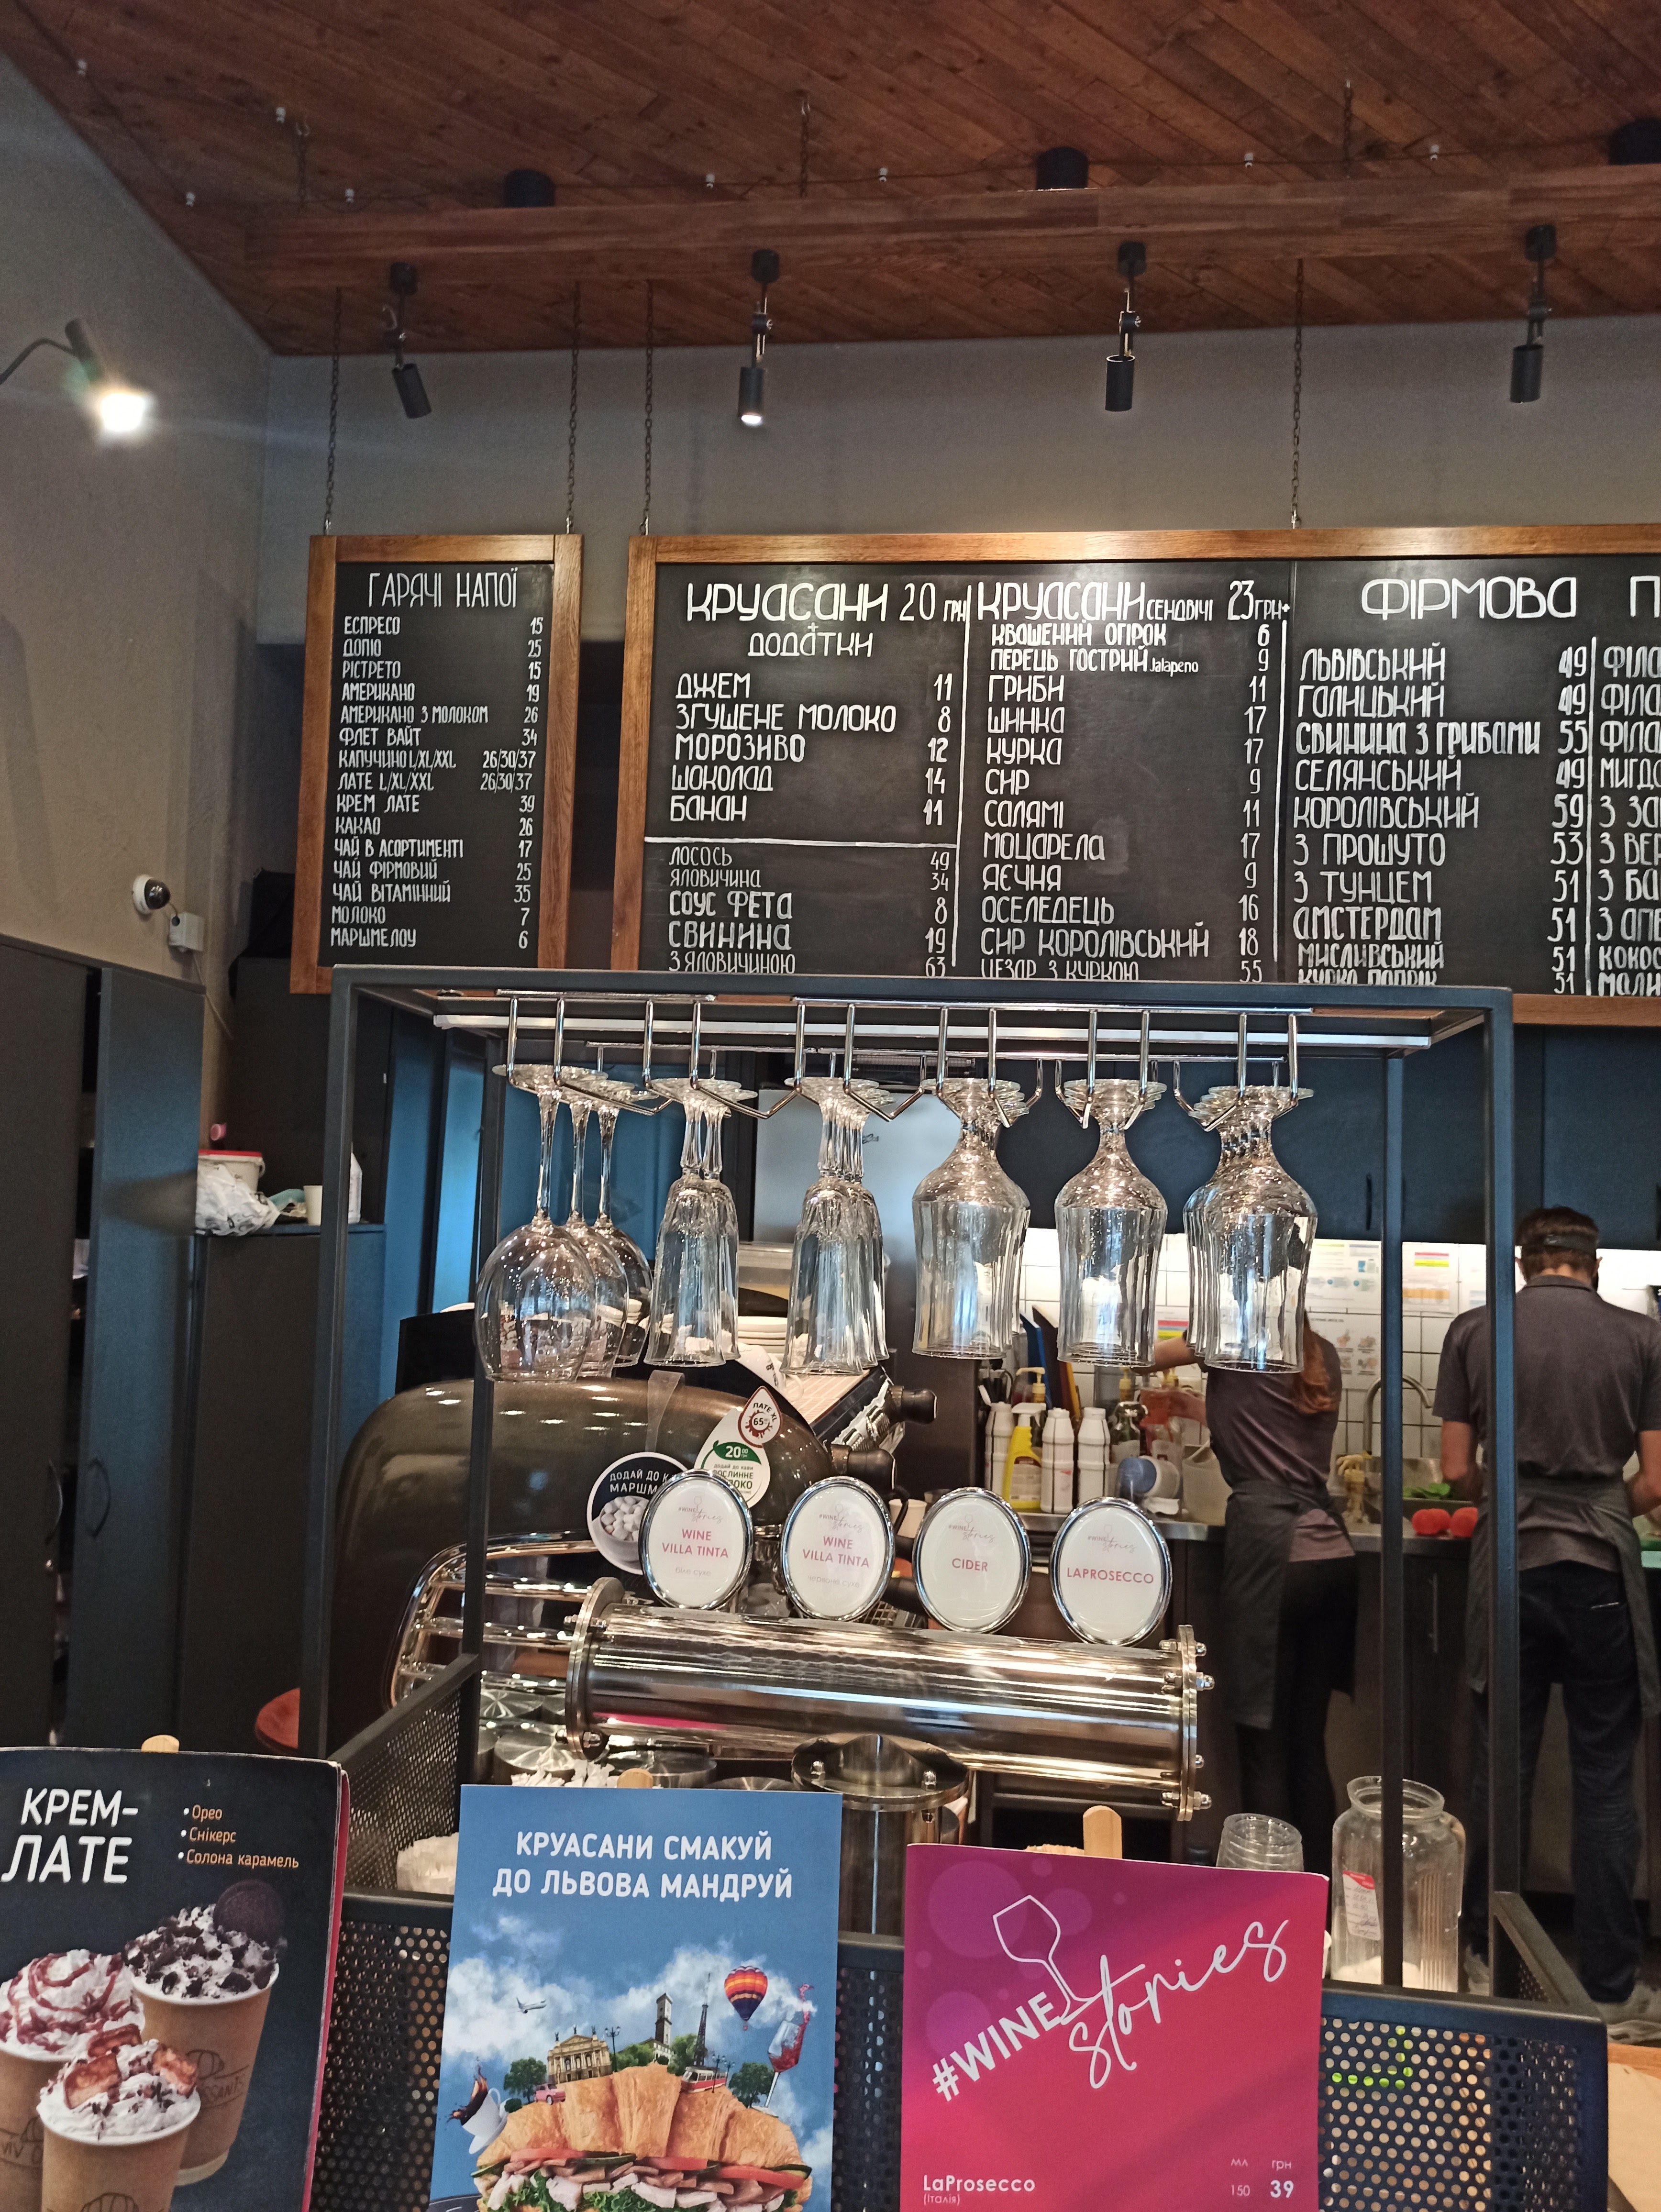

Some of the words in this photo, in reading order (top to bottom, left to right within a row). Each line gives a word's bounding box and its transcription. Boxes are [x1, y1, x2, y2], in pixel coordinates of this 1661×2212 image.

[368, 572, 442, 608] ГАРЯЧІ
[456, 567, 518, 608] НАПОЇ
[1361, 576, 1576, 620] ФІРМОВА
[687, 582, 888, 622] КРУАСАНИ
[899, 582, 936, 621] 20
[978, 582, 1145, 620] КРУАСАНИ
[1146, 599, 1213, 621] СЕНДВІЧІ
[1228, 580, 1254, 620] 23
[344, 616, 400, 635] ЕСПРЕСО
[1105, 622, 1166, 646] ОГІРОК
[1257, 624, 1270, 647] 6
[343, 638, 382, 657] ДОПІО
[528, 639, 543, 658] 25
[748, 632, 873, 657] ДОДАТКИ
[342, 660, 401, 679] РІСТРЕТО
[990, 648, 1059, 673] ПЕРЕЦЬ
[1069, 645, 1148, 671] ГОСТРИЙ
[1150, 658, 1199, 676] Jalapeno
[1258, 648, 1269, 672] 9
[1300, 642, 1445, 681] ЛЬВІВСЬКИЙ
[342, 682, 415, 702] АМЕРИКАНО
[526, 684, 540, 703] 19
[675, 673, 751, 699] ДЖЕМ
[988, 675, 1064, 703] ГРИБИ
[1249, 675, 1266, 703] 11
[1298, 682, 1444, 719] ГАЛИЦЬКИЙ
[1558, 683, 1586, 716] 49
[340, 705, 414, 724] АМЕРИКАНО
[432, 706, 488, 724] МОЛОКОМ
[675, 703, 784, 731] ЗГУЩЕНЕ
[798, 704, 897, 732] МОЛОКО
[938, 706, 951, 733] 8
[987, 707, 1065, 734] ШИНКА
[339, 727, 379, 747] ФЛЕТ
[387, 725, 421, 747] ВАЙТ
[521, 728, 537, 746] 34
[675, 732, 806, 763] МОРОЗИВО
[927, 737, 949, 763] 12
[1296, 722, 1407, 755] СВИНИНА
[1436, 721, 1541, 755] ГРИБАМИ
[483, 747, 536, 771] 26/30/37
[986, 737, 1062, 765] КУРКА
[1244, 738, 1264, 764] 17
[337, 772, 373, 790] ЛАТЕ
[379, 771, 434, 793] L/XL/XXL
[480, 771, 533, 792] 26/30/37
[671, 764, 774, 791] ШОКОЛАД
[925, 767, 945, 795] 14
[985, 768, 1030, 796] СИР
[1250, 768, 1261, 794] 9
[1296, 754, 1461, 792] СЕЛЯНСЬКИЙ
[1555, 758, 1585, 789] 49
[336, 794, 375, 813] КРЕМ
[384, 794, 420, 813] ЛАТЕ
[519, 795, 535, 813] 39
[670, 795, 747, 822] БАНАН
[1294, 792, 1479, 830] КОРОЛІВСЬКИЙ
[1551, 793, 1584, 829] 59
[335, 816, 381, 835] КАКАО
[334, 836, 360, 857] ЧАЙ
[365, 839, 375, 857] В
[378, 839, 464, 858] АСОРТИМЕНТІ
[518, 840, 532, 858] 17
[668, 846, 732, 866] ЛОСОСЬ
[930, 851, 950, 871] 49
[984, 832, 1106, 862] МОЦАРЕЛА
[1240, 832, 1261, 859] 17
[1323, 833, 1446, 866] ПРОШУТО
[333, 857, 361, 879] ЧАЙ
[369, 858, 437, 880] ФІРМОВИЙ
[670, 868, 762, 888] ЯЛОВИЧИНА
[982, 863, 1062, 892] ЯЄЧНЯ
[1244, 862, 1256, 888] 9
[332, 880, 362, 903] ЧАЙ
[371, 880, 451, 903] ВІТАМІННИЙ
[513, 884, 531, 903] 35
[1319, 871, 1432, 905] ТУНЦЕМ
[1552, 869, 1579, 903] 51
[332, 906, 386, 924] МОЛОКО
[520, 907, 530, 926] 7
[669, 890, 716, 917] СОУС
[727, 890, 793, 919] ФЕТА
[934, 896, 948, 924] 8
[982, 896, 1115, 927] ОСЕЛЕДЕЦЬ
[1238, 894, 1259, 922] 16
[1293, 906, 1441, 941] АМСТЕРДАМ
[331, 927, 416, 948] МАРШМЕЛОУ
[518, 930, 529, 949] 6
[668, 920, 792, 951] СВИНИНА
[925, 927, 946, 953] 19
[981, 927, 1025, 955] СИР
[1039, 921, 1208, 958] КОРОЛІВСЬКИЙ
[685, 951, 795, 974] ЯЛОВИЧИНОЮ
[1298, 941, 1444, 970] МИСЛИВСЬКИЙ
[1551, 946, 1575, 971] 51
[1239, 960, 1262, 983] 55
[725, 1446, 741, 1458] 20
[610, 1469, 642, 1482] ДОДАЙ
[646, 1471, 659, 1482] ДО
[682, 1529, 711, 1541] WINE
[823, 1536, 853, 1549] WINE
[662, 1543, 692, 1554] VILLA
[697, 1546, 728, 1558] TINTA
[803, 1549, 833, 1562] VILLA
[838, 1554, 869, 1568] TINTA
[952, 1558, 988, 1572] CIDER
[1067, 1567, 1153, 1583] LAPROSECCO
[20, 1788, 139, 1826] КРЕМ-
[192, 1805, 222, 1821] Орео
[189, 1827, 236, 1844] Снікерс
[516, 1831, 653, 1860] КРУАСАНИ
[664, 1830, 772, 1861] СМАКУЙ
[1, 1835, 133, 1883] ЛАТЕ
[187, 1849, 233, 1867] Солона
[238, 1853, 299, 1869] карамель
[492, 1869, 531, 1897] ДО
[541, 1869, 650, 1898] ЛЬВОВА
[661, 1868, 792, 1902] МАНДРУЙ
[932, 1991, 1060, 2102] #WINE
[1061, 1920, 1289, 2089] stories
[1272, 2158, 1292, 2171] грн
[923, 2175, 1035, 2192] LaProsecco
[1230, 2184, 1250, 2197] 150
[1270, 2180, 1294, 2198] 39
